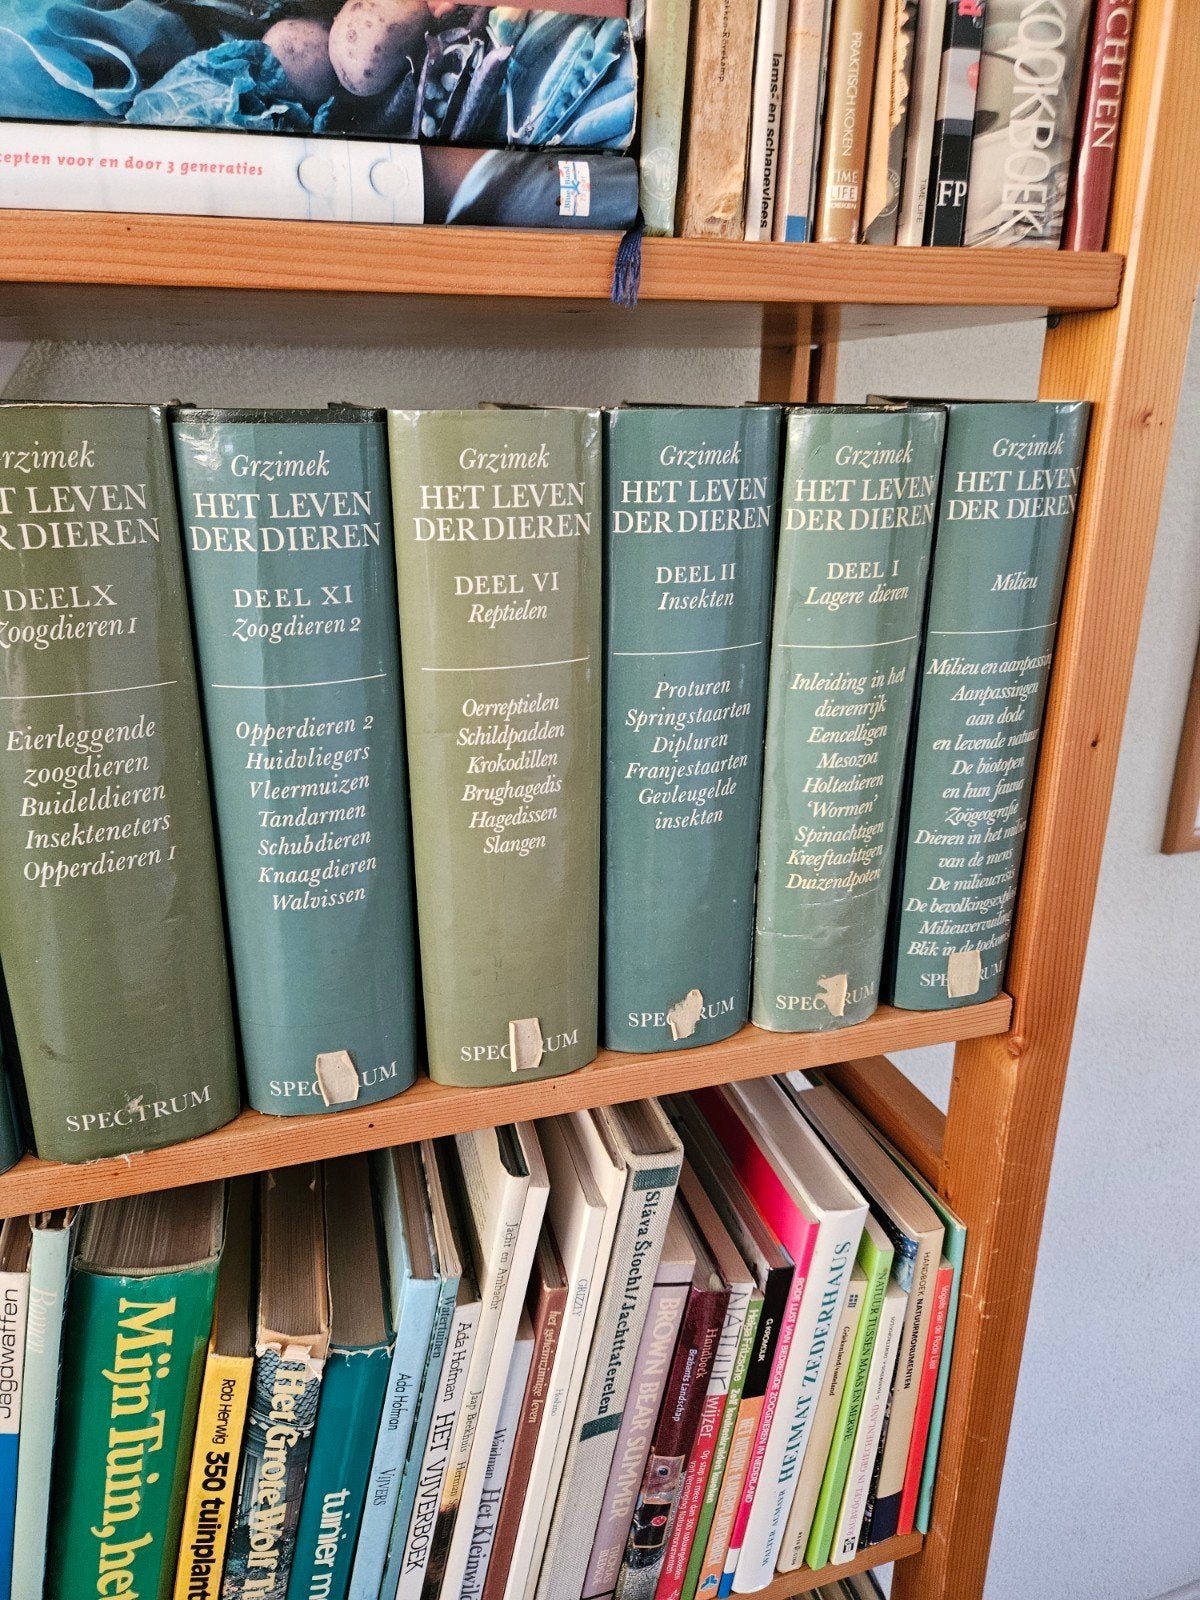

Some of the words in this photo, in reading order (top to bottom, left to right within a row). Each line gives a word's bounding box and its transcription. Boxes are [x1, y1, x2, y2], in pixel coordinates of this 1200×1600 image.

[846, 32, 862, 105] PRAKTISCH
[767, 103, 777, 123] en
[842, 108, 855, 156] KOKEN
[57, 155, 94, 167] voor
[100, 158, 119, 168] en
[125, 156, 162, 170] door
[167, 162, 175, 173] 3
[180, 162, 263, 176] generaties
[831, 186, 856, 199] LIFE
[937, 181, 967, 207] FP
[621, 480, 682, 504] HET
[688, 477, 768, 502] LEVEN
[794, 479, 855, 502] HET
[955, 471, 1012, 492] HET
[193, 493, 260, 519] HET
[268, 491, 372, 518] LEVEN
[420, 485, 484, 510] HET
[491, 482, 586, 508] LEVEN
[946, 500, 1000, 521] DER
[455, 575, 524, 596] DEEL
[532, 572, 559, 592] VI
[655, 565, 716, 584] DEEL
[720, 563, 736, 580] II
[827, 561, 885, 580] DEEL
[991, 572, 1038, 592] Milieu
[234, 587, 311, 608] DEEL
[321, 585, 353, 605] XI
[658, 589, 734, 611] Insekten
[804, 586, 864, 611] Lagere
[868, 583, 909, 604] dieren
[468, 600, 547, 629] Reptielen
[233, 616, 346, 644] Zoogdieren
[349, 618, 361, 632] 2
[927, 658, 979, 676] Milieu
[655, 679, 731, 700] Proturen
[790, 672, 865, 695] Inleiding
[871, 669, 885, 688] in
[950, 680, 1039, 706] Aanpassingen
[462, 694, 559, 722] Oerreptielen
[625, 701, 751, 733] Springstaarten
[815, 697, 887, 720] dierenrijk
[7, 715, 155, 754] Eierleggende
[236, 717, 356, 746] Opperdieren
[456, 721, 565, 751] Schildpadden
[651, 733, 728, 757] Dipluren
[807, 724, 887, 745] Eencelligen
[954, 732, 1006, 751] levende
[23, 754, 149, 788] zoogdieren
[246, 744, 370, 771] Huidvliegers
[467, 749, 558, 774] Krokodillen
[624, 754, 748, 785] Franjestaarten
[816, 751, 878, 769] Mesozoa
[950, 760, 974, 775] De
[977, 756, 1025, 776] biotopen
[250, 774, 370, 800] Vleermuizen
[462, 775, 562, 805] Brughagedis
[638, 781, 737, 807] Gevleugelde
[802, 775, 884, 793] Holtedieren
[963, 782, 991, 798] hun
[20, 784, 166, 817] Buideldieren
[259, 803, 366, 828] Tandarmen
[469, 804, 558, 832] Hagedissen
[655, 808, 723, 830] insekten
[26, 814, 171, 849] Insekteneters
[258, 828, 371, 856] Schubdieren
[484, 834, 546, 857] Slangen
[795, 822, 884, 847] Spinachtigen
[914, 829, 964, 846] Dieren
[23, 849, 161, 887] Opperdieren
[259, 855, 377, 887] Knaagdieren
[786, 844, 883, 871] Kreeftachtigen
[786, 868, 881, 892] Duizendpoten
[927, 877, 950, 891] De
[272, 885, 365, 911] Walvissen
[905, 898, 927, 913] De
[638, 1191, 661, 1237] Sláva
[503, 1222, 519, 1247] Jacht
[500, 1252, 509, 1263] en
[917, 1252, 930, 1297] HANDBOEK
[490, 1268, 508, 1310] Ambacht
[793, 1277, 805, 1303] RODE
[871, 1271, 887, 1315] NATUUR
[938, 1285, 949, 1309] Vogels
[432, 1295, 455, 1358] Watertuinen
[548, 1311, 561, 1326] het
[743, 1309, 759, 1339] Helga
[936, 1310, 944, 1324] van
[454, 1322, 472, 1348] Ada
[642, 1298, 681, 1376] BROWN
[783, 1324, 794, 1343] VAN
[862, 1316, 877, 1356] TUSSEN
[904, 1298, 924, 1389] NATUURMONUMENTEN
[932, 1335, 941, 1354] Rode
[0, 1288, 18, 1419] Jagdwaffen
[101, 1297, 177, 1418] Mijn
[534, 1329, 555, 1397] geheimzinnige
[598, 1302, 636, 1415] Jachttaferelen
[681, 1348, 697, 1382] Brabants
[696, 1328, 718, 1378] Handboek
[734, 1340, 752, 1382] Fritzsche
[778, 1395, 811, 1484] HEIMAT
[802, 1241, 850, 1387] ZEDERHAUS
[443, 1350, 467, 1402] Hofman
[772, 1344, 789, 1391] BEDREIGDE
[855, 1358, 869, 1389] MAAS
[219, 1379, 236, 1402] Rob
[268, 1368, 306, 1421] Het
[395, 1372, 412, 1393] Ada
[852, 1389, 862, 1402] EN
[387, 1395, 408, 1431] Hofman
[466, 1390, 481, 1410] Jaap
[529, 1400, 543, 1423] leven
[629, 1383, 660, 1433] BEAR
[672, 1383, 690, 1422] Landschap
[212, 1404, 233, 1445] Herwig
[430, 1411, 456, 1451] HET
[760, 1391, 779, 1444] ZOOGDIEREN
[843, 1403, 860, 1441] MERWE
[461, 1413, 478, 1452] Beekhuis
[484, 1428, 506, 1479] Waidman
[757, 1445, 766, 1455] IN
[90, 1409, 166, 1538] Tuin,
[202, 1452, 230, 1492] 350
[258, 1424, 301, 1507] Grote
[450, 1461, 466, 1496] Herman
[609, 1435, 647, 1522] SUMMER
[745, 1455, 764, 1503] NEDERLAND
[373, 1468, 397, 1506] VIJVERS
[405, 1457, 446, 1575] VIJVERBOEK
[477, 1488, 501, 1519] Het
[314, 1488, 350, 1568] tuinier
